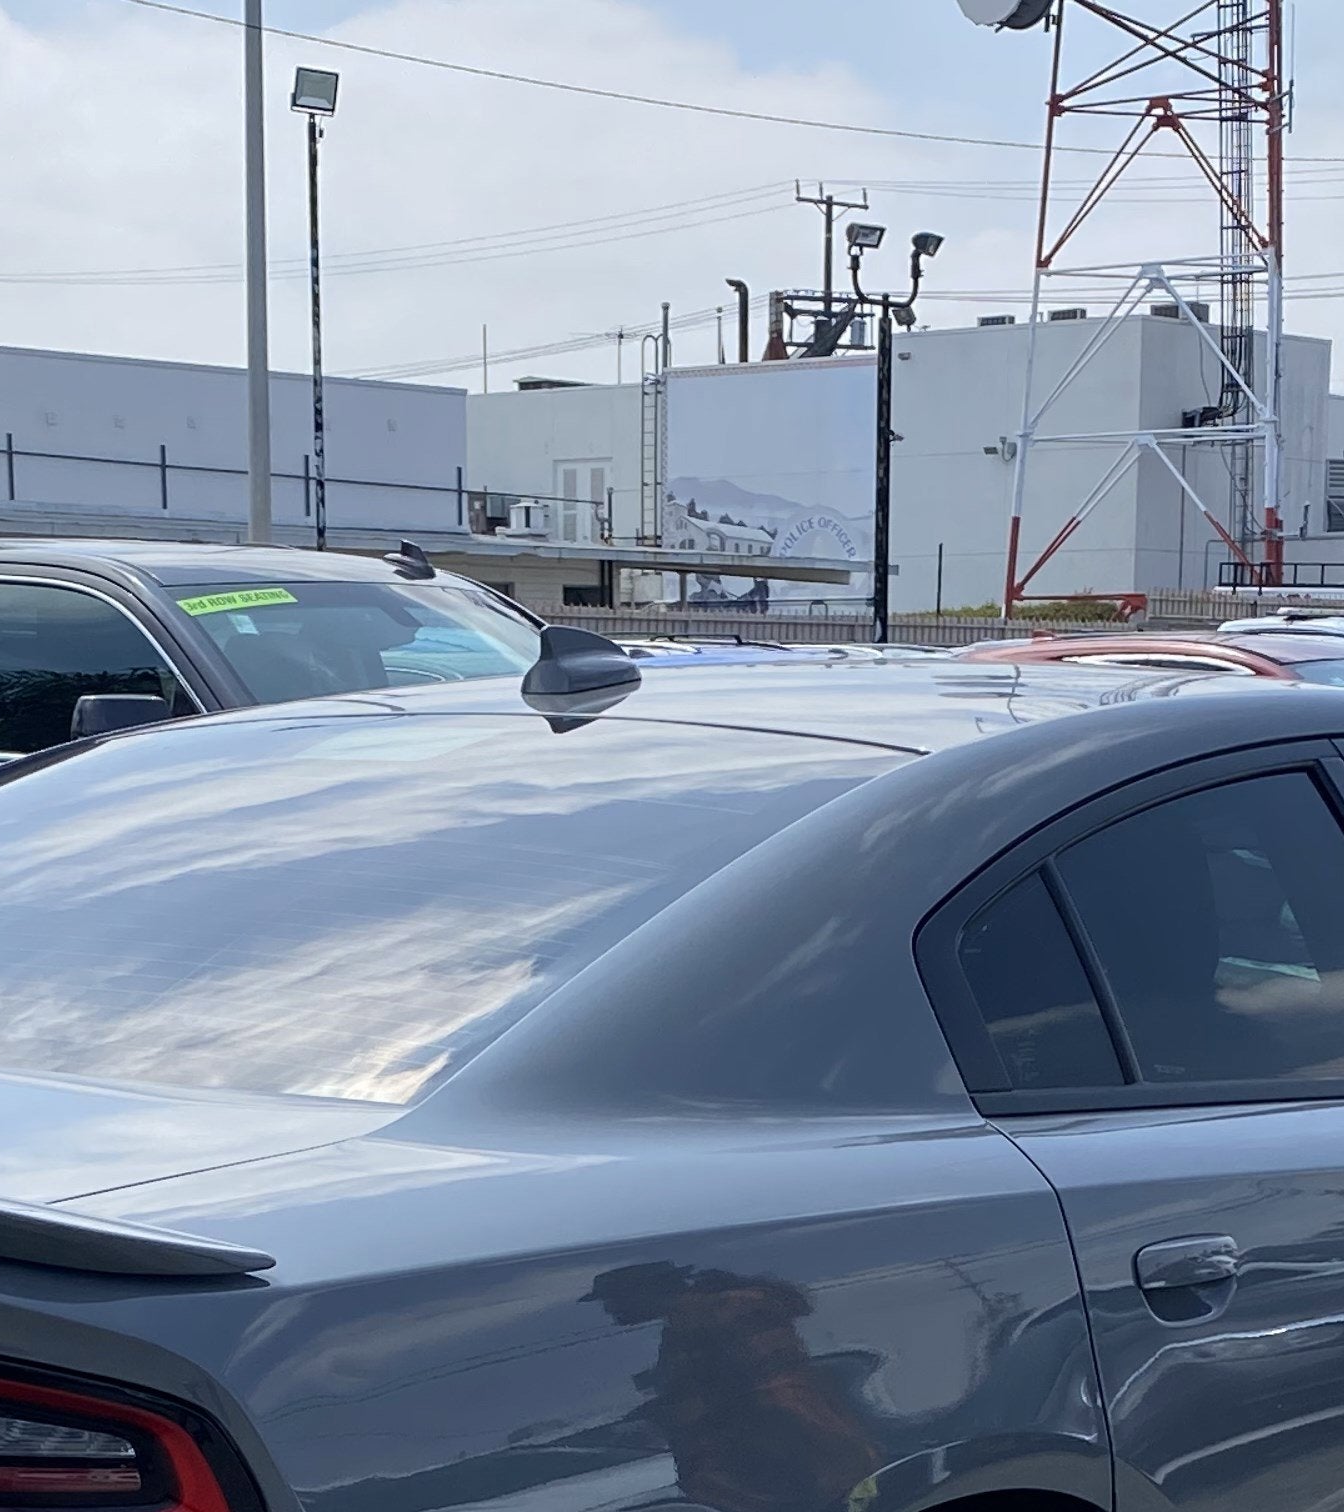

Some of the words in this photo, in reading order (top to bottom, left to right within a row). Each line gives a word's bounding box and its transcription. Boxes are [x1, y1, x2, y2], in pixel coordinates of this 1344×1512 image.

[779, 517, 815, 557] POLICE
[817, 516, 857, 558] OFFICER
[183, 600, 208, 612] 3rd
[207, 595, 236, 607] ROW
[238, 589, 289, 603] SEATING
